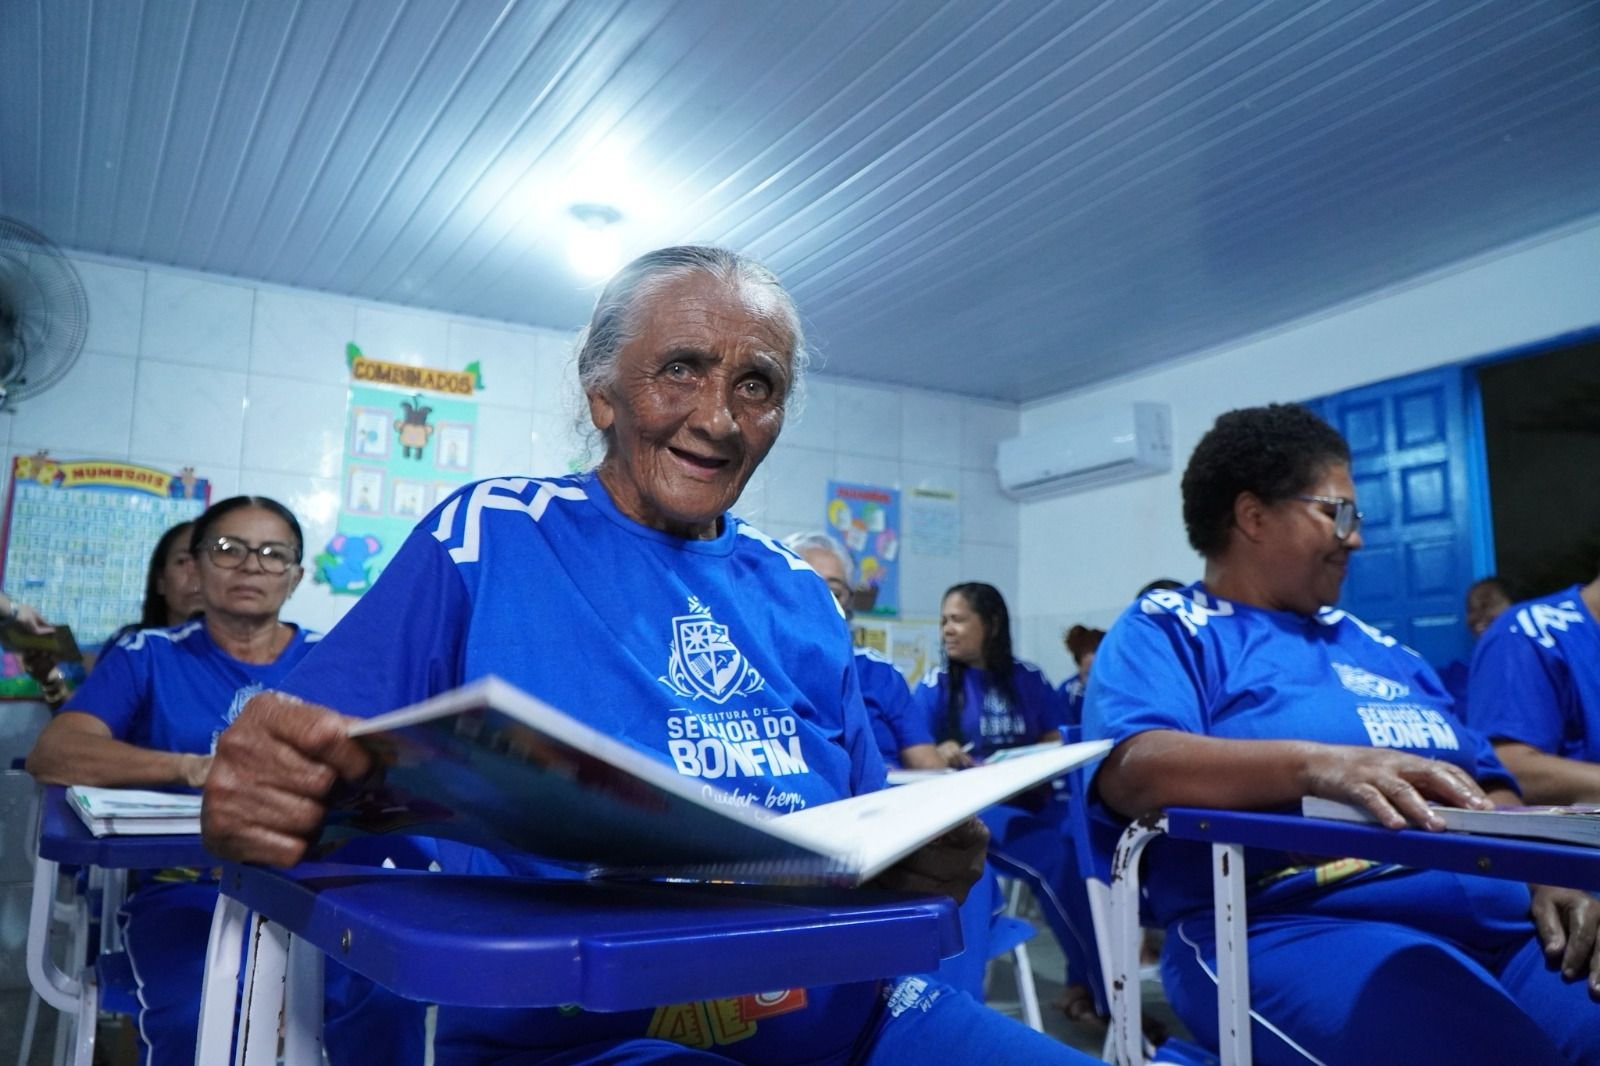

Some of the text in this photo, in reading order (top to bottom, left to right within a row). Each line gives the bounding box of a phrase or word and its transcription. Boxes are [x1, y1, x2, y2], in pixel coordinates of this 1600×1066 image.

[354, 360, 472, 393] COMBINADOS
[753, 707, 769, 716] DE
[763, 715, 797, 738] DO
[1363, 721, 1460, 751] BONFIM
[668, 736, 809, 779] BONFIM
